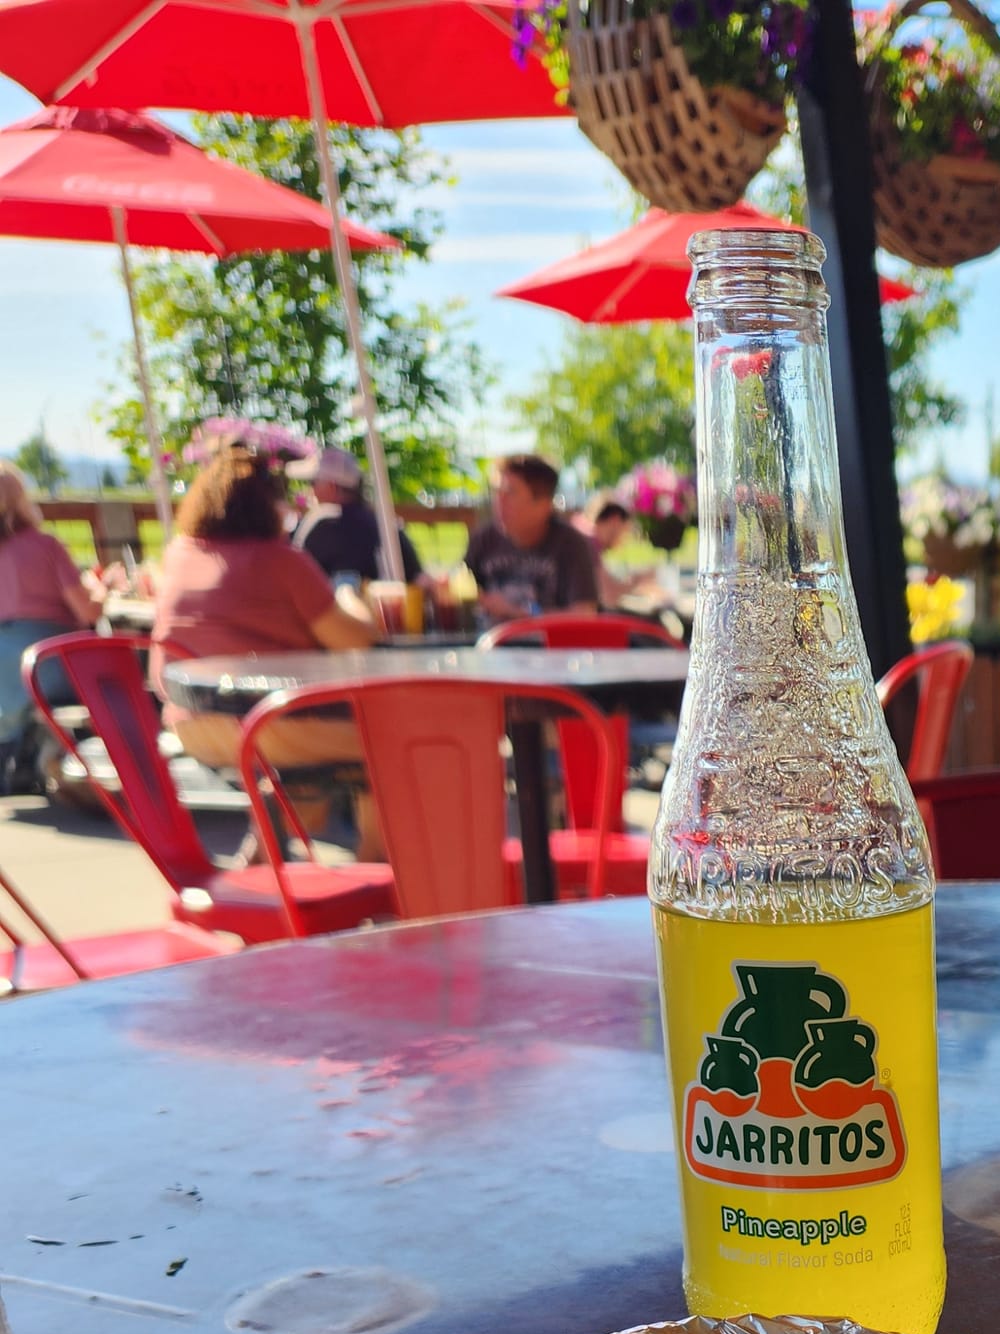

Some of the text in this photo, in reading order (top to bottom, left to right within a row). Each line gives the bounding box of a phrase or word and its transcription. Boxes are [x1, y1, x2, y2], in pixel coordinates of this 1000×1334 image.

[695, 1116, 886, 1165] JARRITOS
[721, 1206, 867, 1245] Pineapple
[777, 1252, 827, 1268] Flavor
[833, 1248, 873, 1266] Soda
